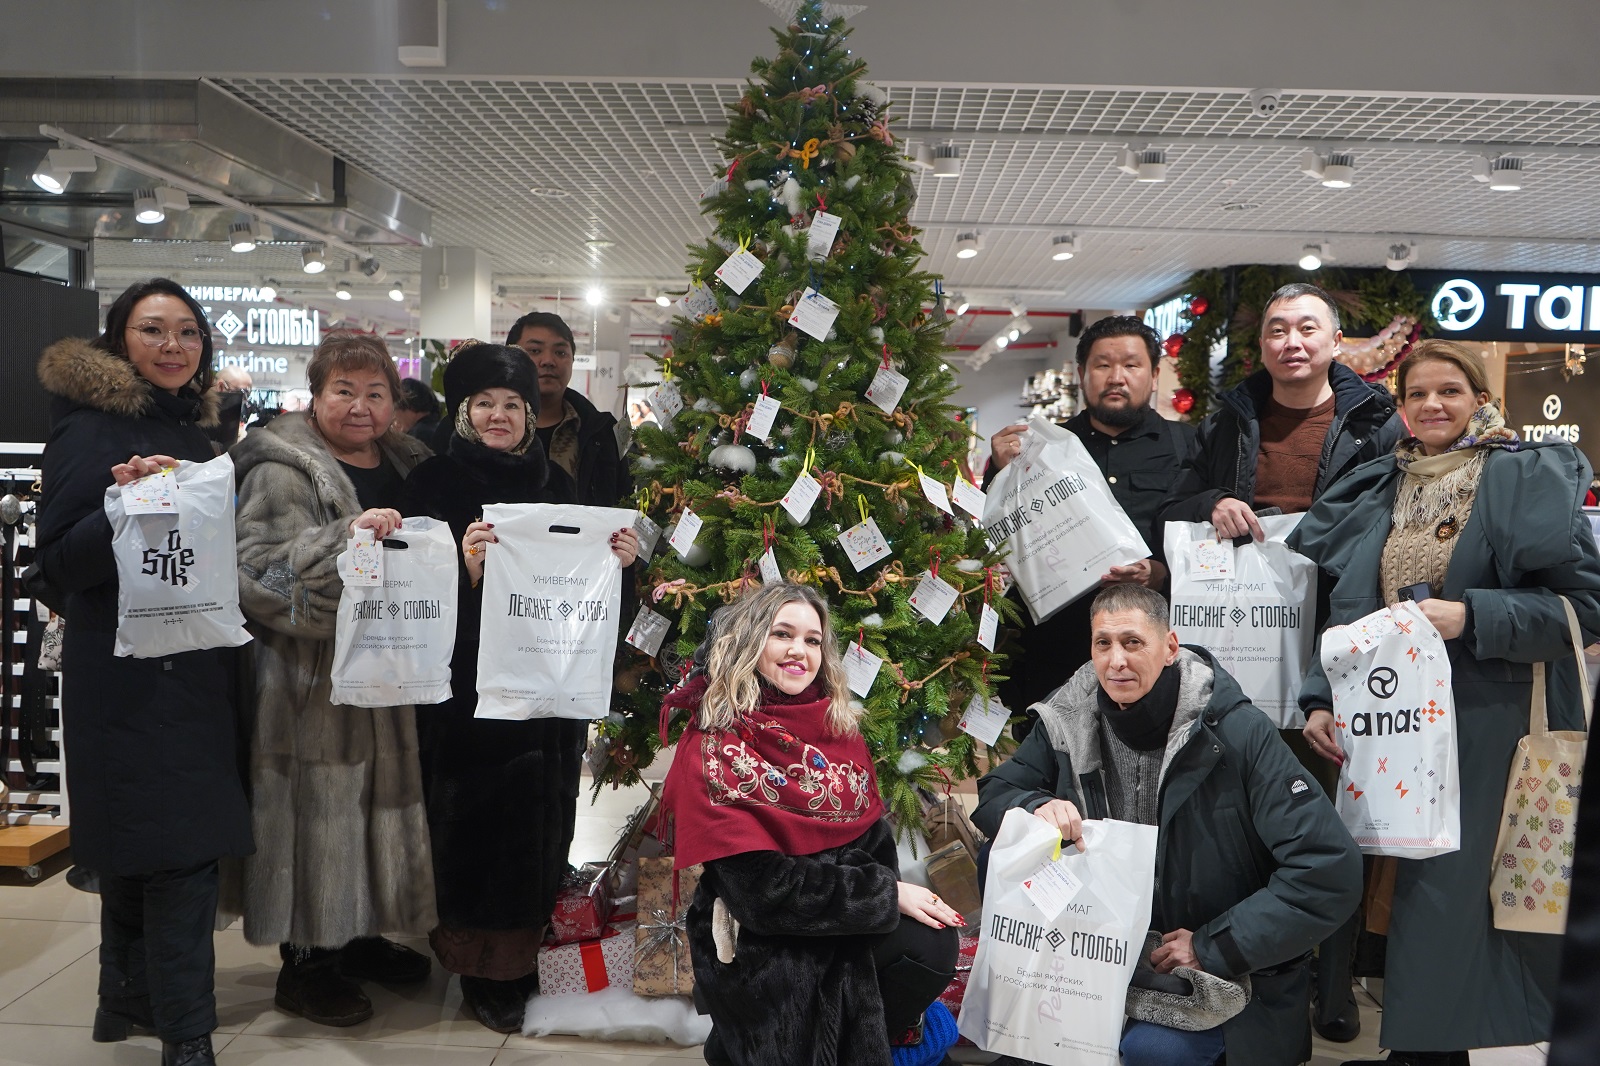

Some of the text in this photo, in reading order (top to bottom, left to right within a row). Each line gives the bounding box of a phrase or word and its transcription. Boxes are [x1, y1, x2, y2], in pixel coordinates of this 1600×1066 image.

[246, 308, 319, 346] СТОЛБЫ
[987, 472, 1087, 545] ЛЕНСКИЕ СТОЛБЫ
[382, 580, 413, 589] ВЕРМАГ
[532, 574, 589, 586] УНИВЕРМАГ
[403, 600, 441, 620] СТОЛБЫ
[1173, 604, 1300, 629] ЛЕНСКИЕ СТОЛБЫ
[1236, 655, 1284, 664] дизайнеров
[1070, 931, 1128, 967] СТОЛБЫ
[1044, 972, 1084, 986] якутских
[1049, 984, 1103, 1002] дизайнеров
